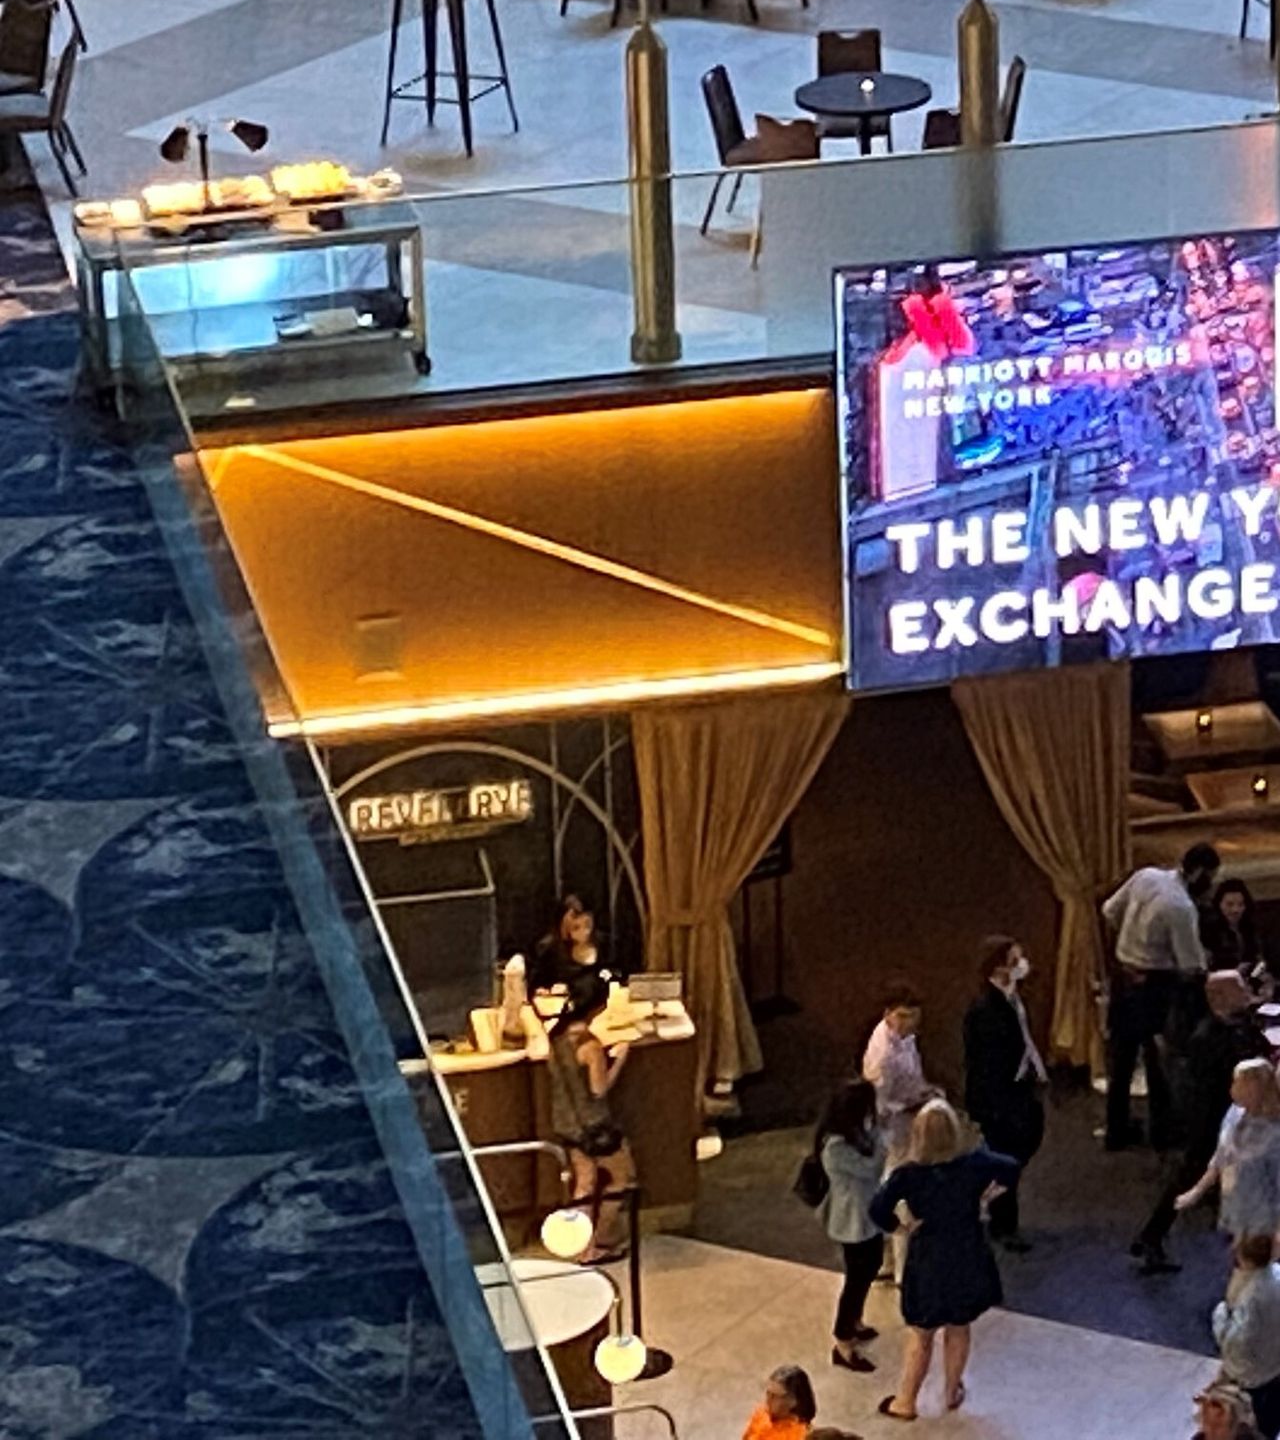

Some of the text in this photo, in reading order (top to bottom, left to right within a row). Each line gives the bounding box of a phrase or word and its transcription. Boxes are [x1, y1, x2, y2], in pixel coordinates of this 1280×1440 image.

[902, 343, 1191, 390] MARRIOTT MARQUIS
[904, 387, 1051, 418] NEW YORK
[886, 510, 1030, 574] THE
[1054, 492, 1209, 558] NEW
[889, 563, 1278, 654] EXCHANGE
